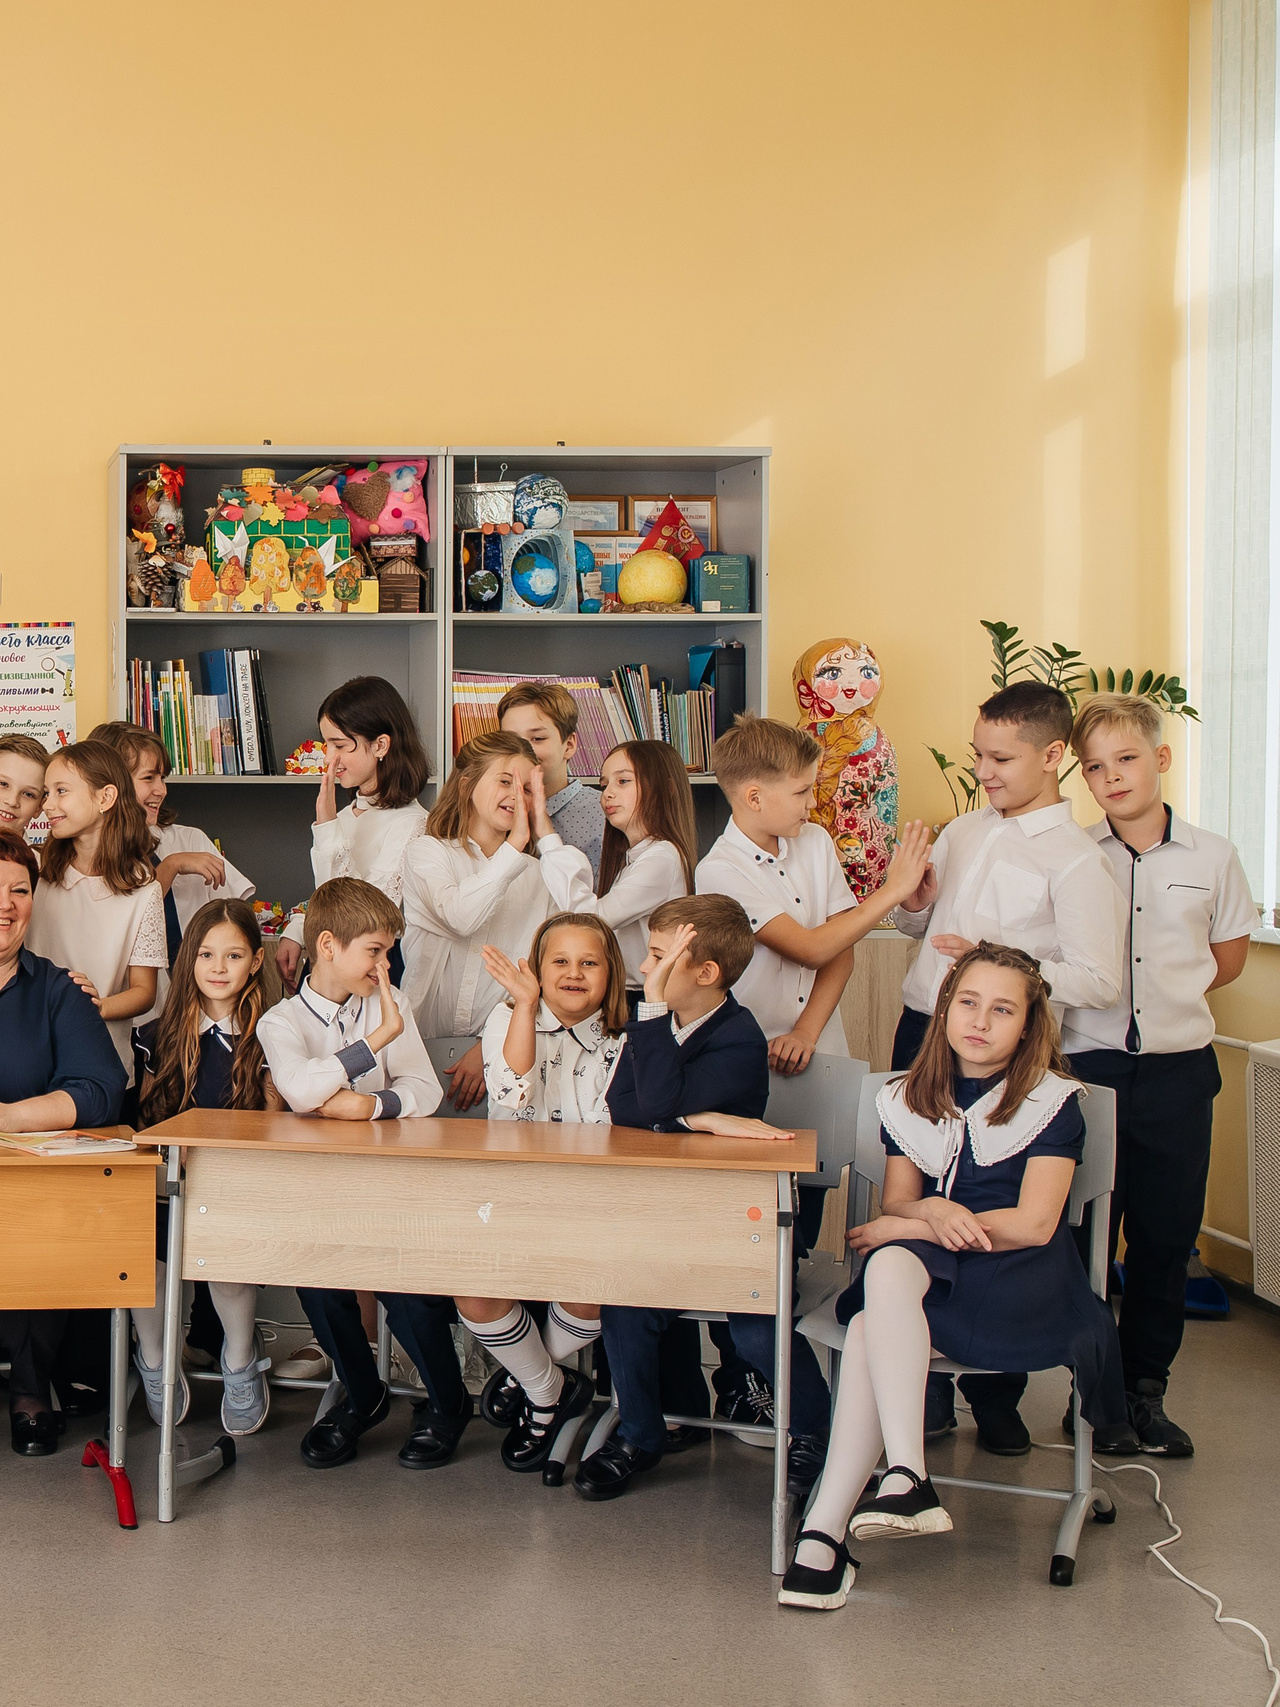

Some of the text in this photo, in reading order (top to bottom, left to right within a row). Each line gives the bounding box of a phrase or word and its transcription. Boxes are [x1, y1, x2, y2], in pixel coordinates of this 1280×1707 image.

[26, 633, 72, 647] класса
[242, 683, 249, 692] НА
[242, 694, 251, 717] ХОККЕЙ
